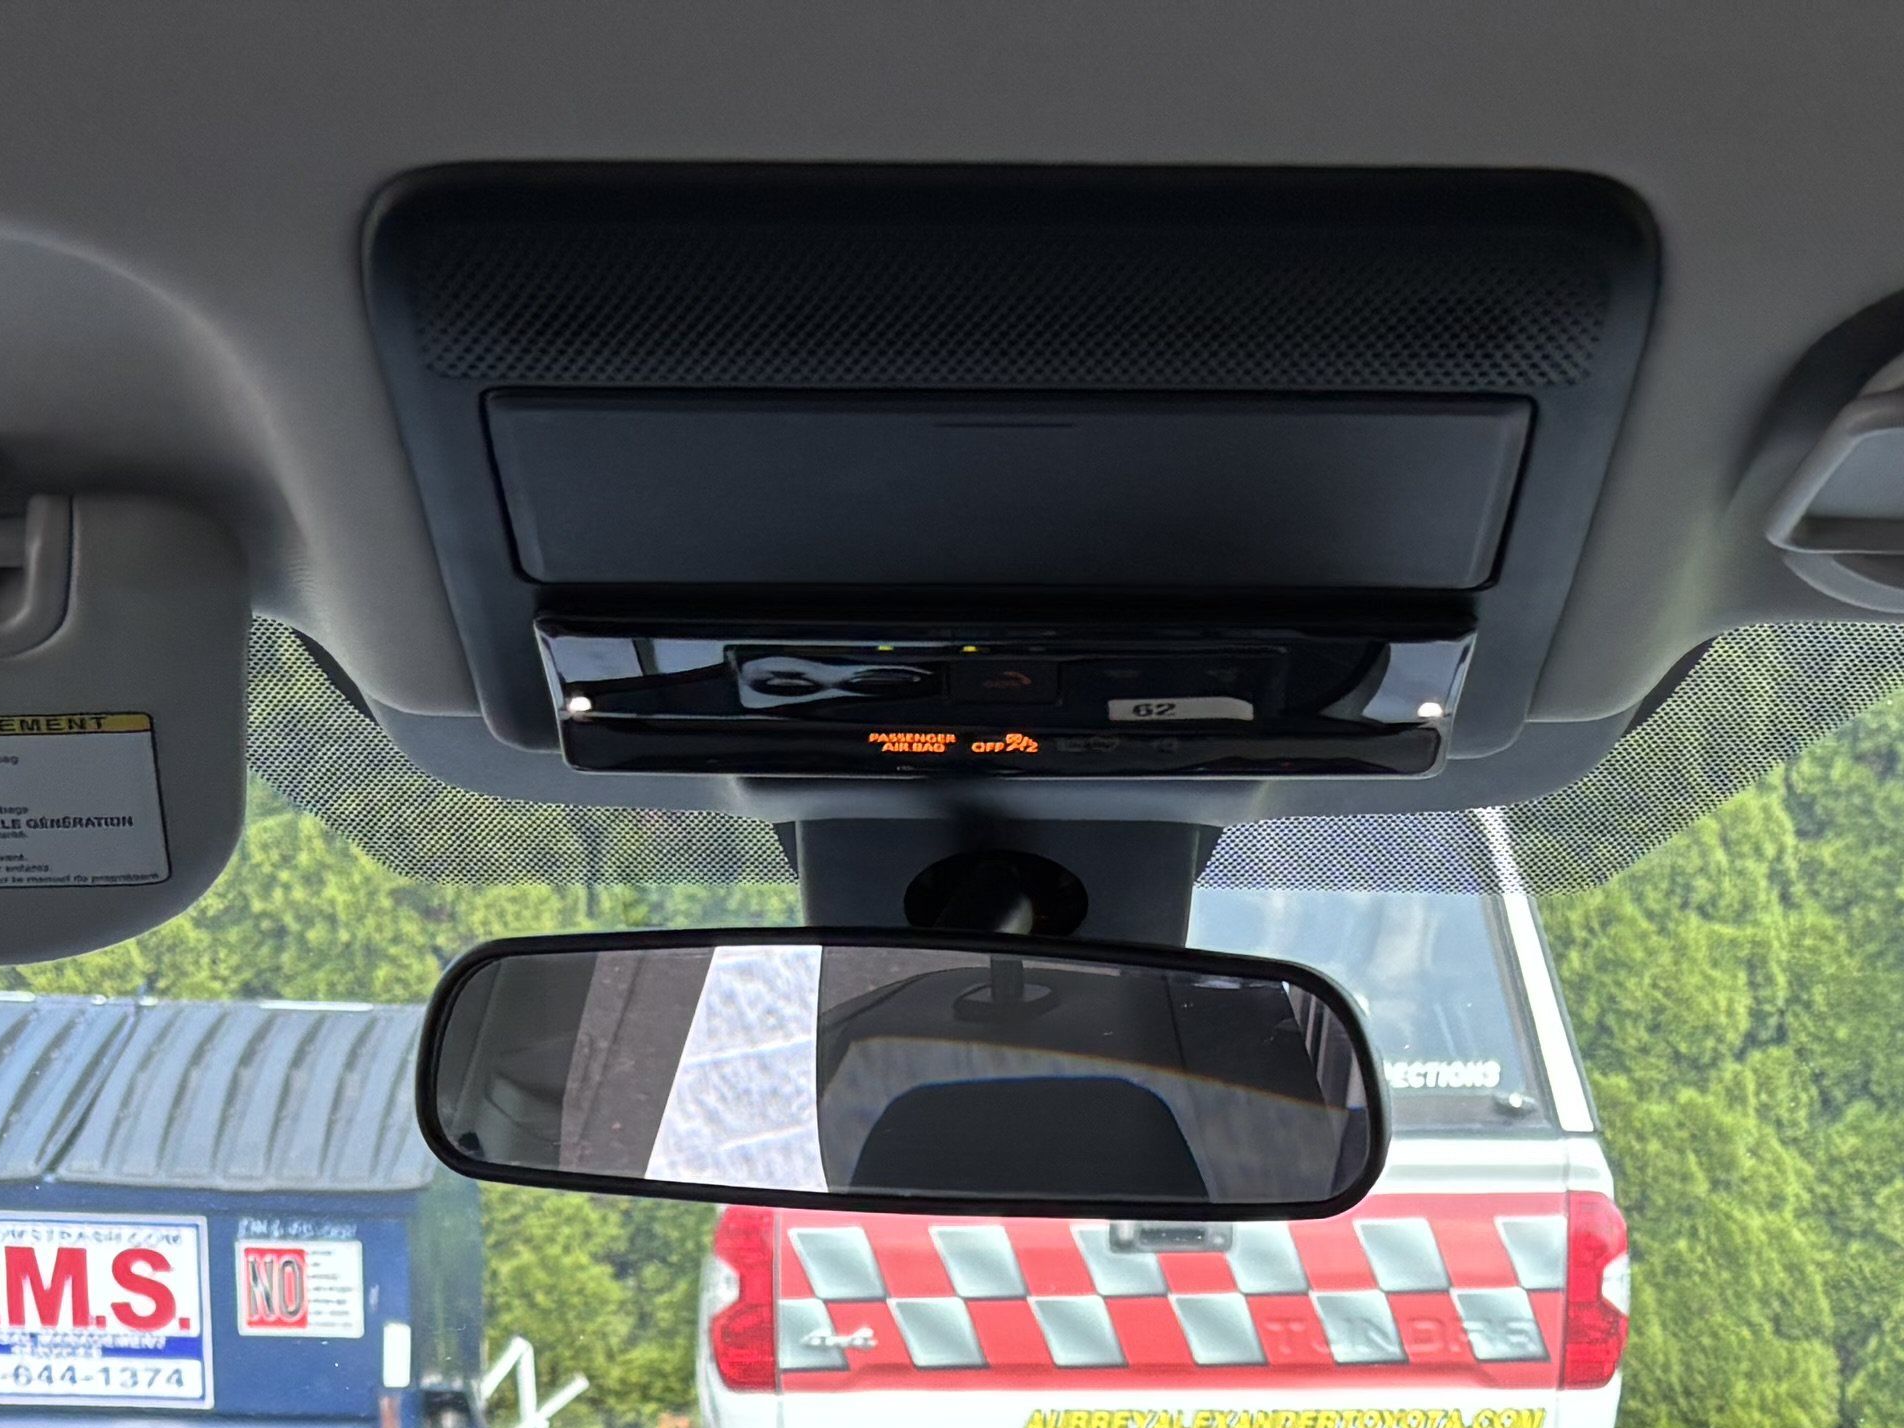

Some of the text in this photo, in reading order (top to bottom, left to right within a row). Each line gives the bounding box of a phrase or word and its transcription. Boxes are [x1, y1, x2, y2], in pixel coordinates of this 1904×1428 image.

[868, 733, 956, 743] PASSENGER
[971, 742, 1005, 752] OFF
[248, 1255, 305, 1322] NO
